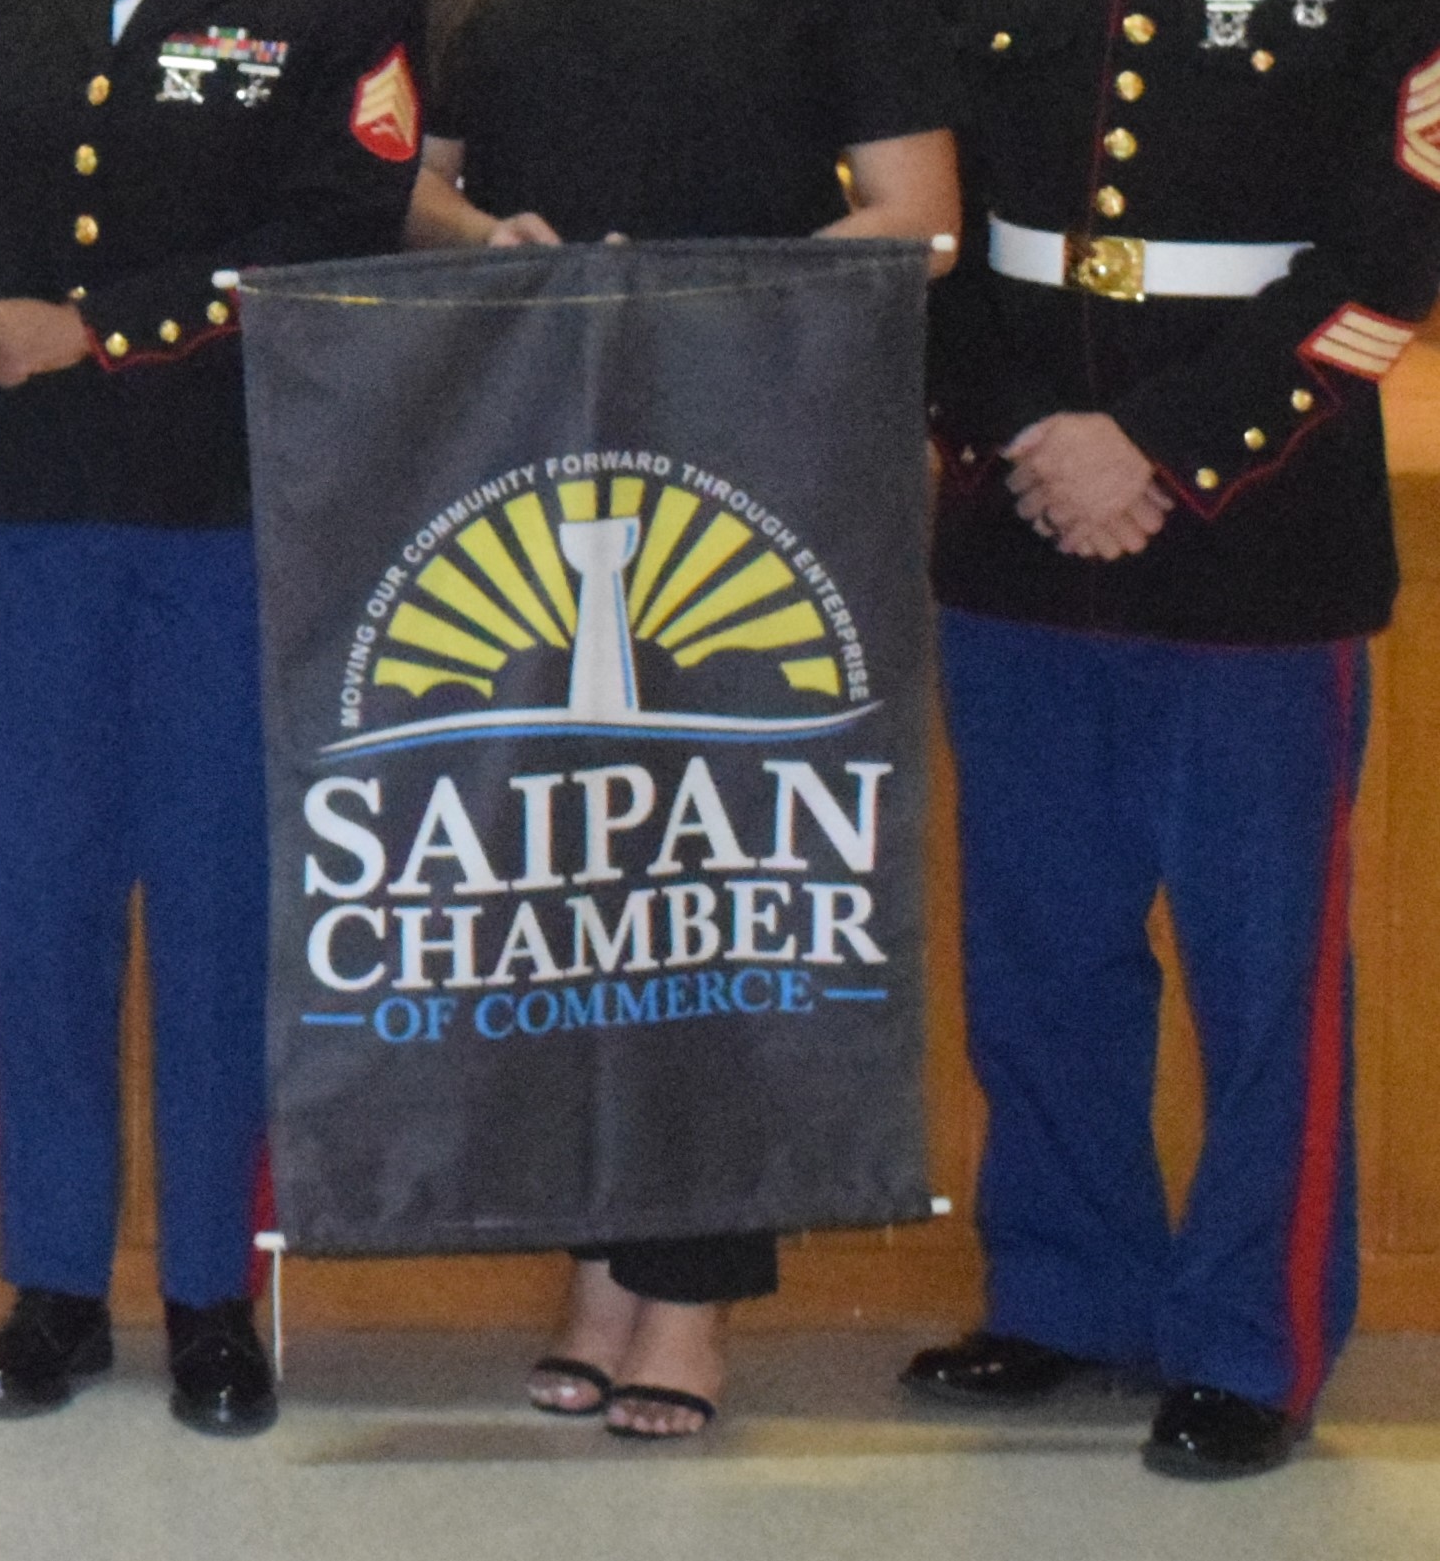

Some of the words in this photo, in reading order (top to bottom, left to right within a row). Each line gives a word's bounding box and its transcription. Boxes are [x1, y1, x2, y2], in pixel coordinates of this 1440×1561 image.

[339, 623, 378, 729] MOVING
[366, 564, 409, 616] OUR
[402, 463, 538, 565] COMMUNITY
[545, 449, 672, 479] FORWARD
[681, 462, 798, 552] THROUGH
[790, 546, 871, 703] ENTERPRISE
[303, 756, 894, 900] SAIPAN
[306, 880, 888, 991] CHAMBER
[372, 995, 460, 1043] OF
[473, 969, 816, 1039] COMMERCE
